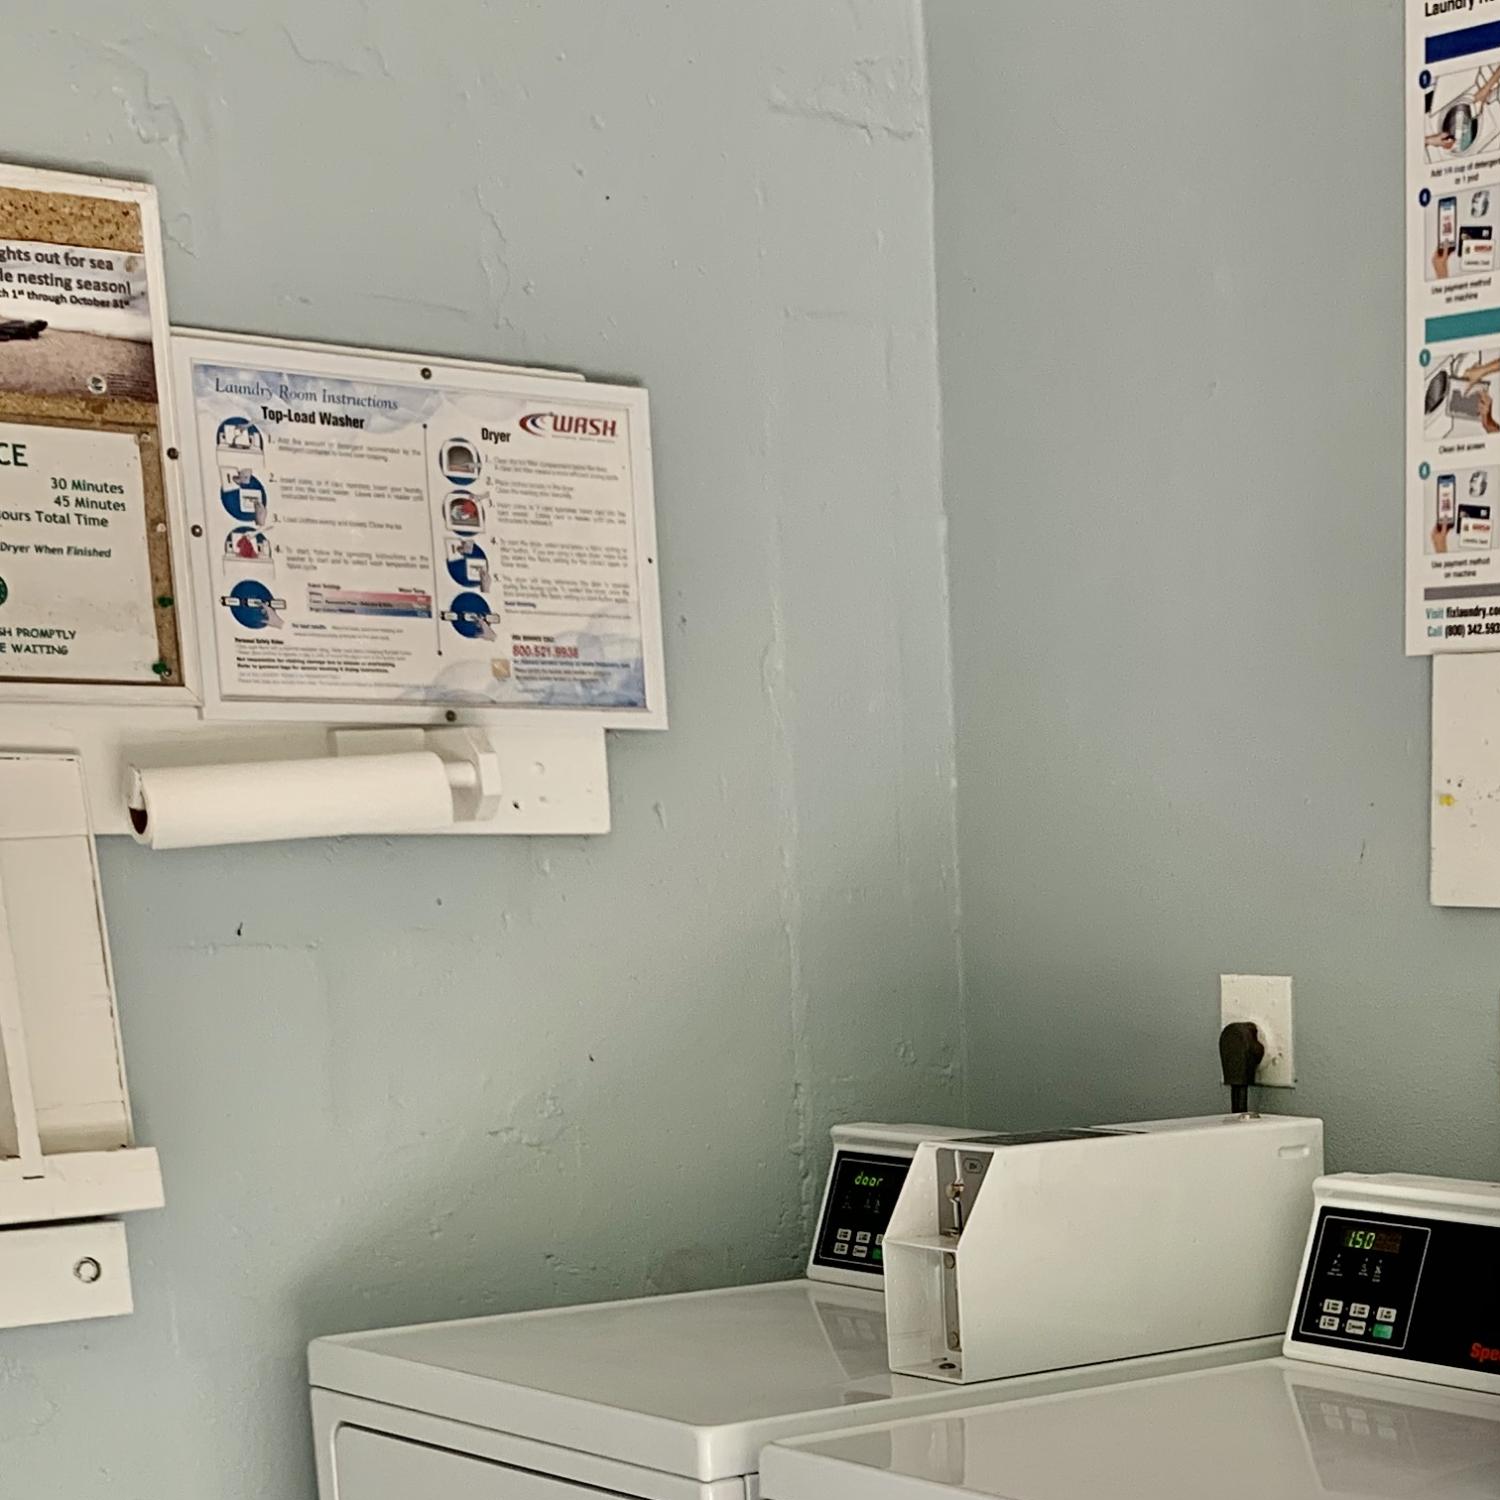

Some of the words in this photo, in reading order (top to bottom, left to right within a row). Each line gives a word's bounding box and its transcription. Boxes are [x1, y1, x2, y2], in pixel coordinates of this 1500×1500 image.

[35, 253, 60, 264] out
[64, 252, 86, 267] for
[90, 258, 113, 271] sea
[18, 272, 72, 291] nesting
[77, 279, 131, 296] season!
[27, 291, 67, 305] through
[70, 295, 109, 308] October
[1422, 353, 1428, 363] 1
[215, 378, 273, 400] Laundry
[279, 384, 317, 403] Room
[322, 389, 398, 411] Instructions
[261, 406, 315, 425] Top-Load
[319, 412, 364, 429] Washer
[552, 414, 617, 437] WASH
[481, 427, 511, 444] Dryer
[50, 477, 67, 490] 30
[72, 479, 124, 494] Minutes
[54, 495, 70, 508] 45
[75, 496, 126, 511] Minutes
[35, 511, 70, 525] Total
[75, 513, 109, 527] Time
[0, 543, 30, 554] Dryer
[34, 544, 63, 555] When
[67, 545, 112, 558] Finished
[1426, 607, 1444, 620] Visit
[16, 627, 76, 639] PROMPTLY
[1427, 624, 1442, 637] Call
[1445, 624, 1465, 639] (800)
[11, 644, 68, 655] WAITING
[854, 1171, 883, 1186] door
